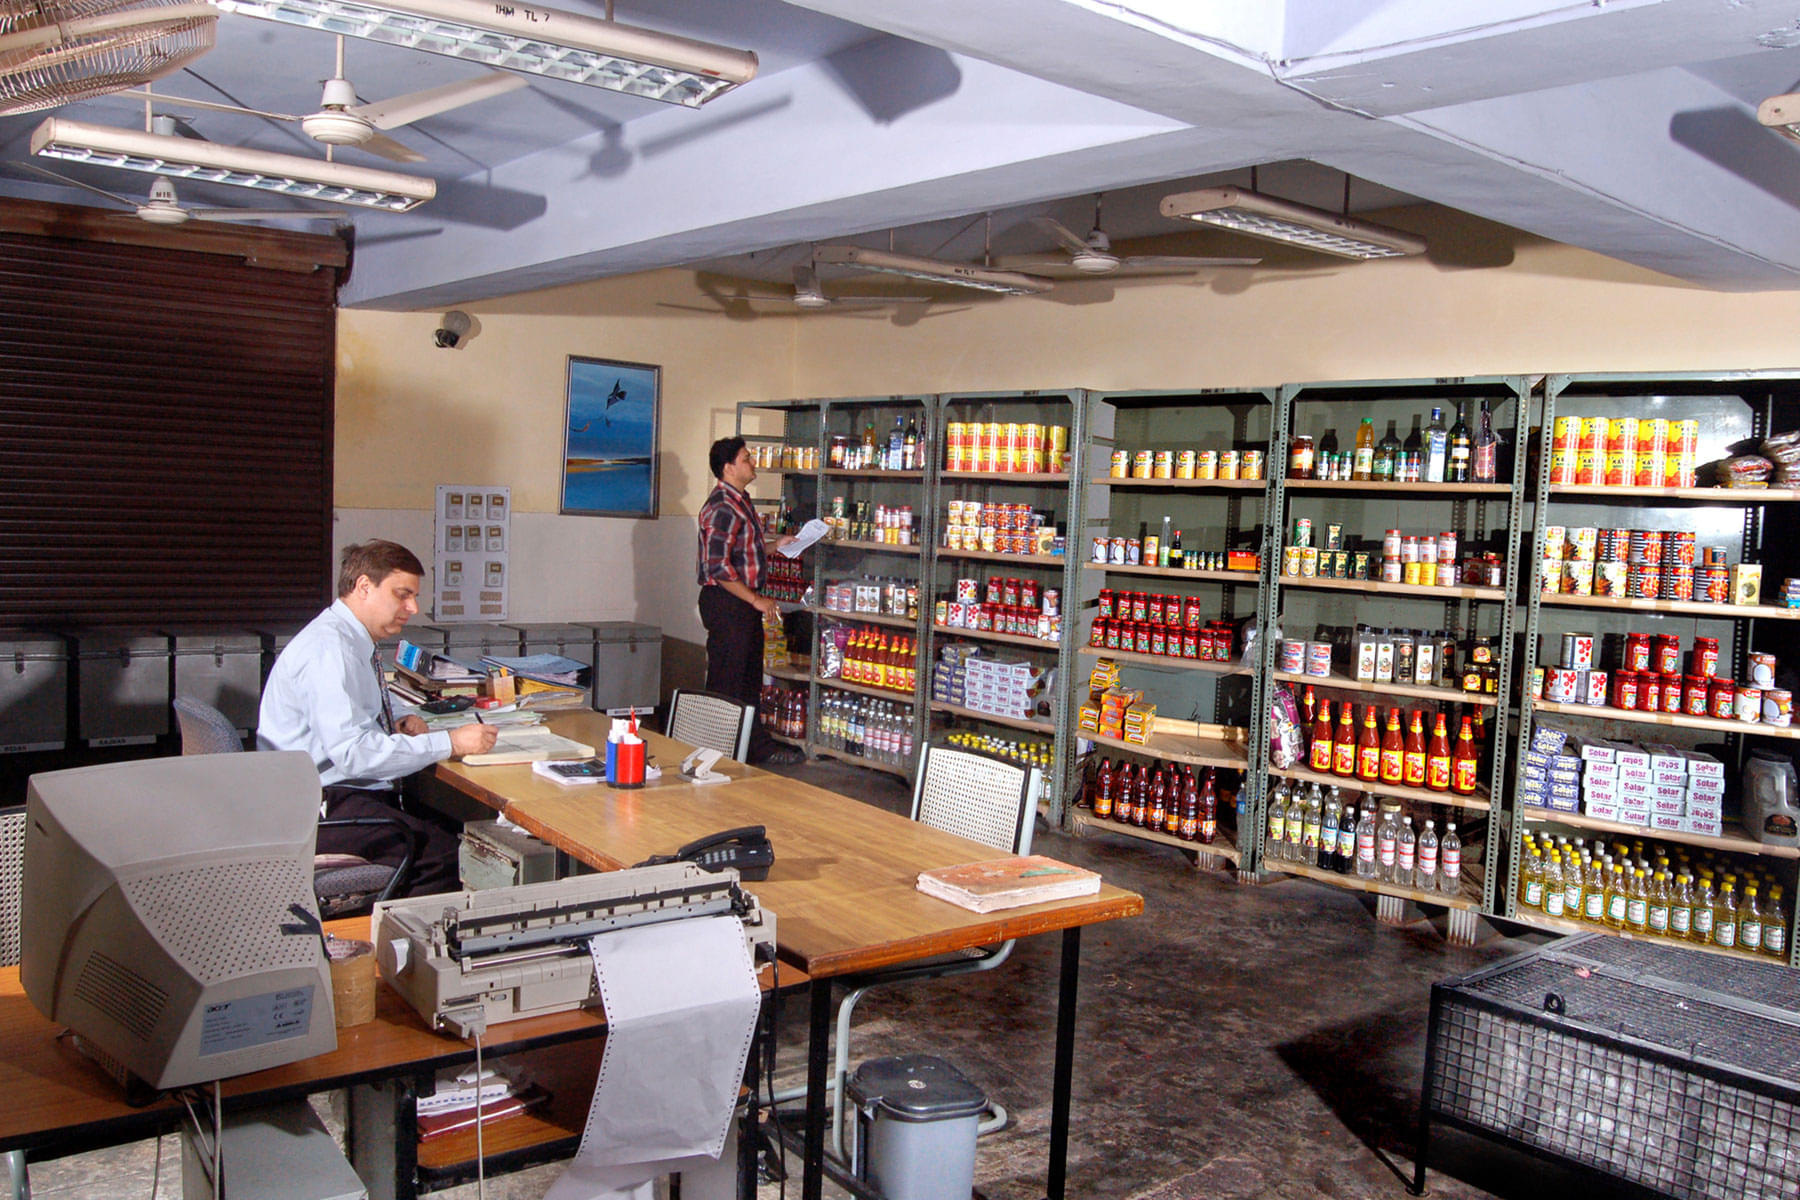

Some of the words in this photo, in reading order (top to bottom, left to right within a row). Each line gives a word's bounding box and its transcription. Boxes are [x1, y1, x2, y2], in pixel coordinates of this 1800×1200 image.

[496, 4, 515, 16] IHM
[524, 9, 538, 22] TL
[544, 12, 550, 22] 7
[1588, 748, 1609, 757] Solar
[1622, 757, 1644, 766] Solar
[1589, 776, 1611, 786] Solar
[1659, 772, 1681, 781] Solar
[1623, 782, 1646, 792] Solar
[1695, 779, 1719, 788] Solar
[1591, 790, 1612, 800] Solar
[1657, 786, 1680, 796] Solar
[1693, 792, 1716, 802] Solar
[1592, 805, 1613, 815] Solar
[1656, 801, 1679, 810] Solar
[1624, 811, 1645, 820] Solar
[1657, 816, 1680, 826] Solar
[1692, 821, 1715, 831] Solar
[207, 1002, 232, 1013] acer
